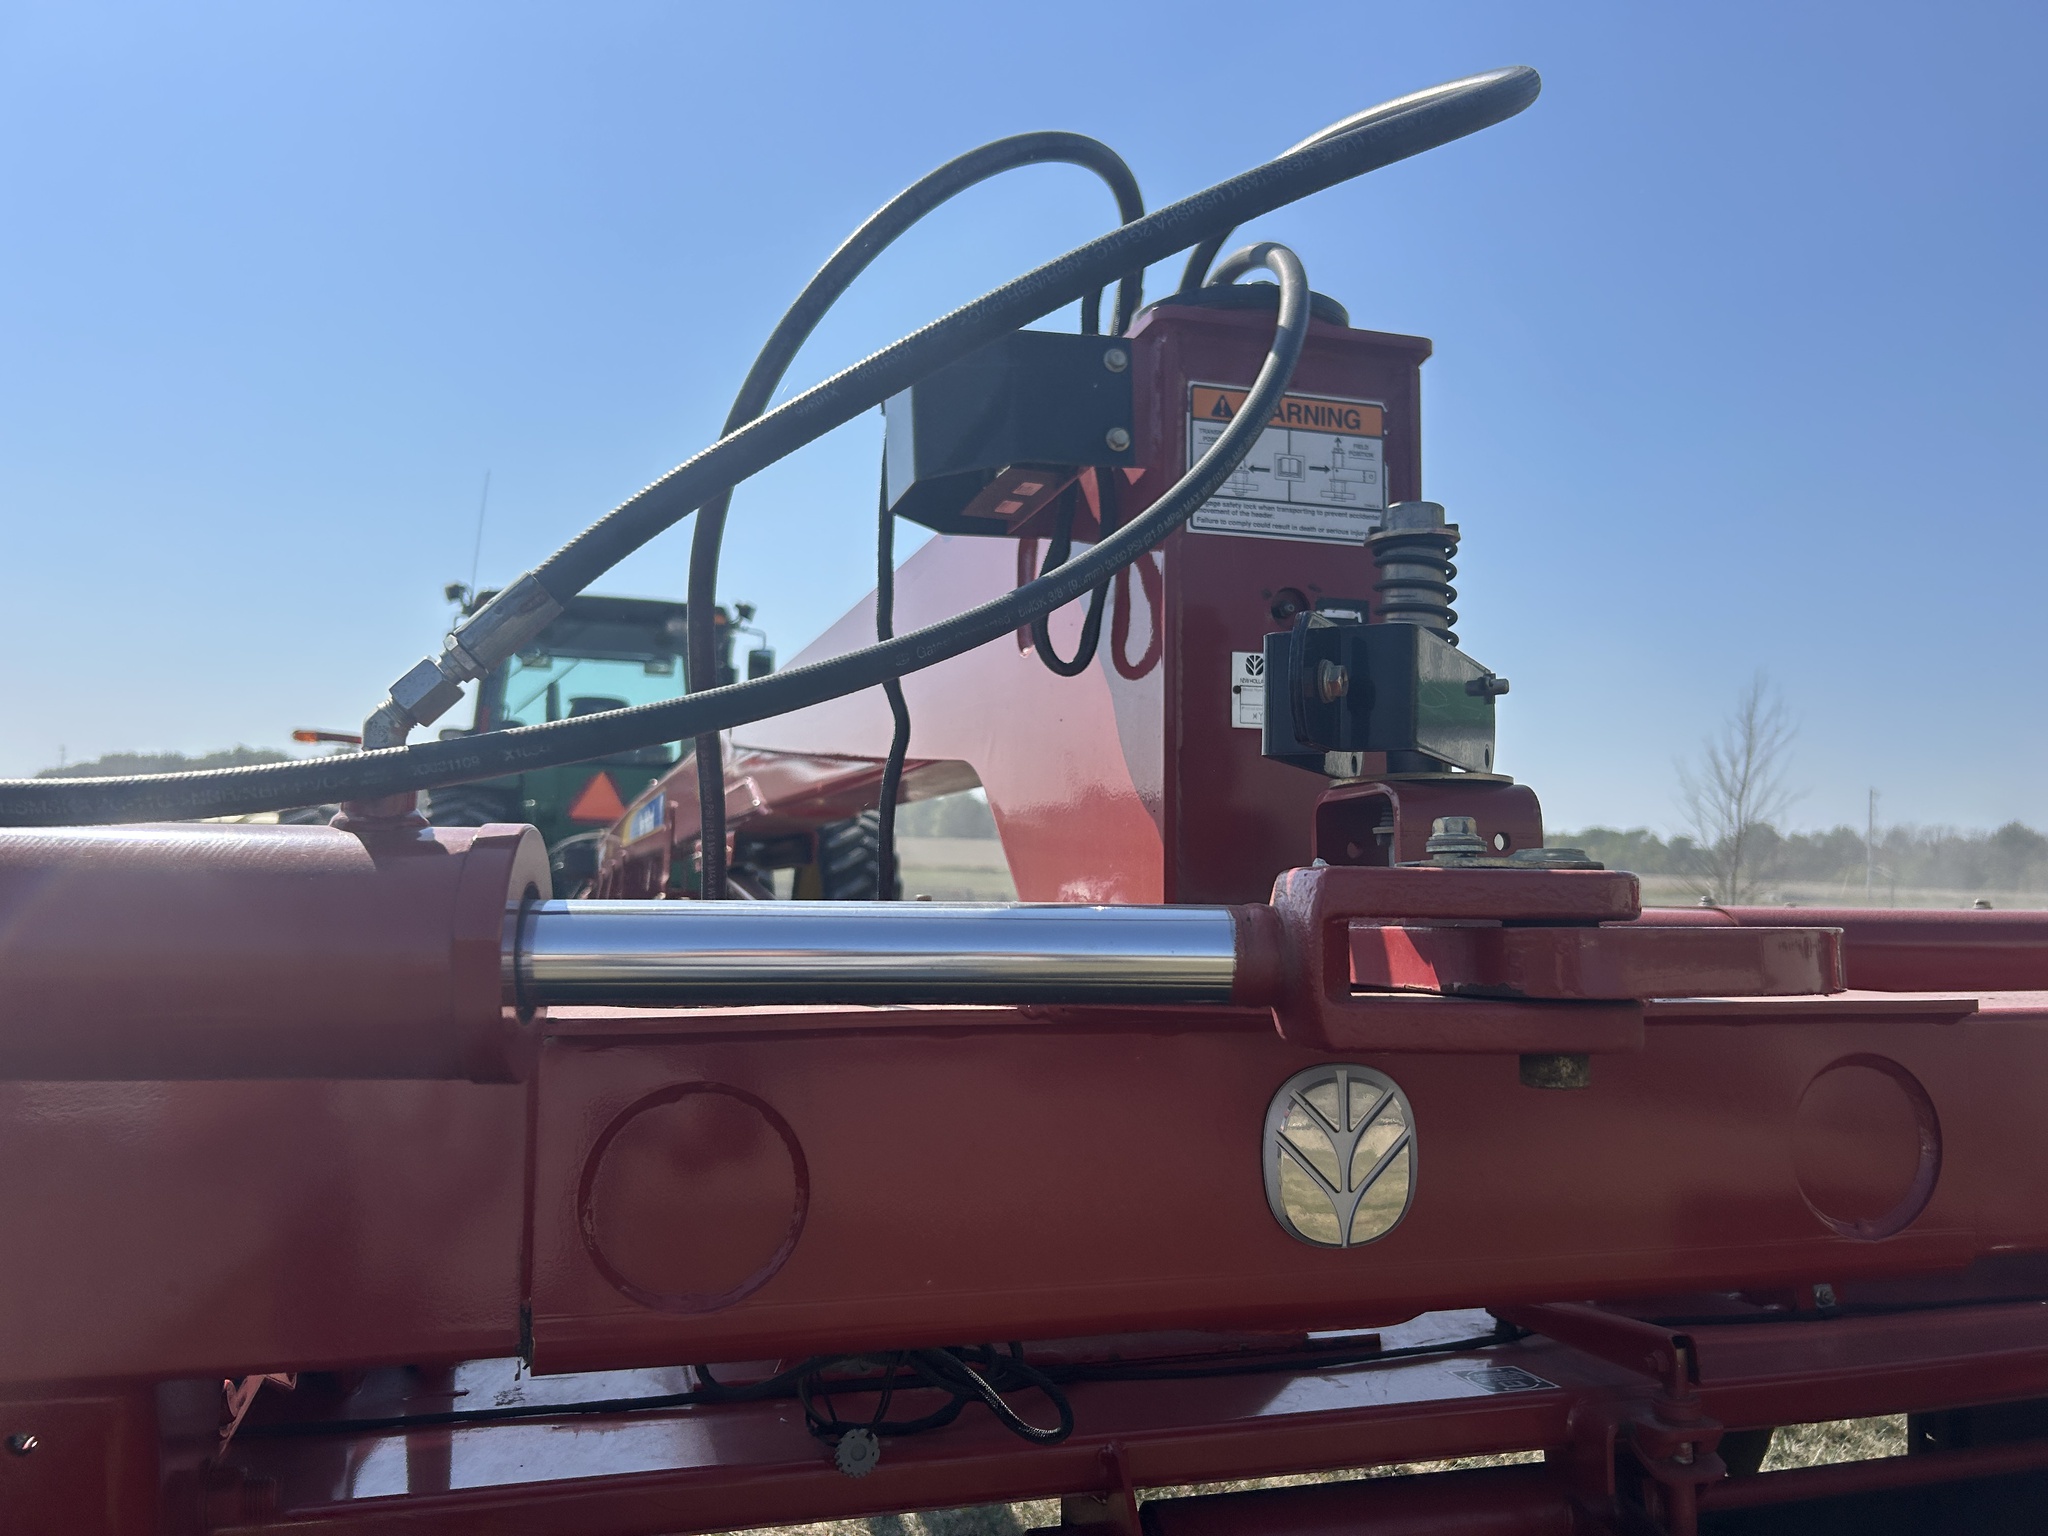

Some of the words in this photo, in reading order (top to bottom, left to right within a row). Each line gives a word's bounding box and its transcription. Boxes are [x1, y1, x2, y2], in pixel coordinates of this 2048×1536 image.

[1268, 402, 1361, 430] ARNING
[1222, 502, 1242, 510] safety
[1276, 505, 1316, 516] transporting
[1196, 516, 1218, 524] Failure
[1228, 520, 1251, 528] comply
[1102, 548, 1128, 570] 3000
[1124, 536, 1143, 555] PSI
